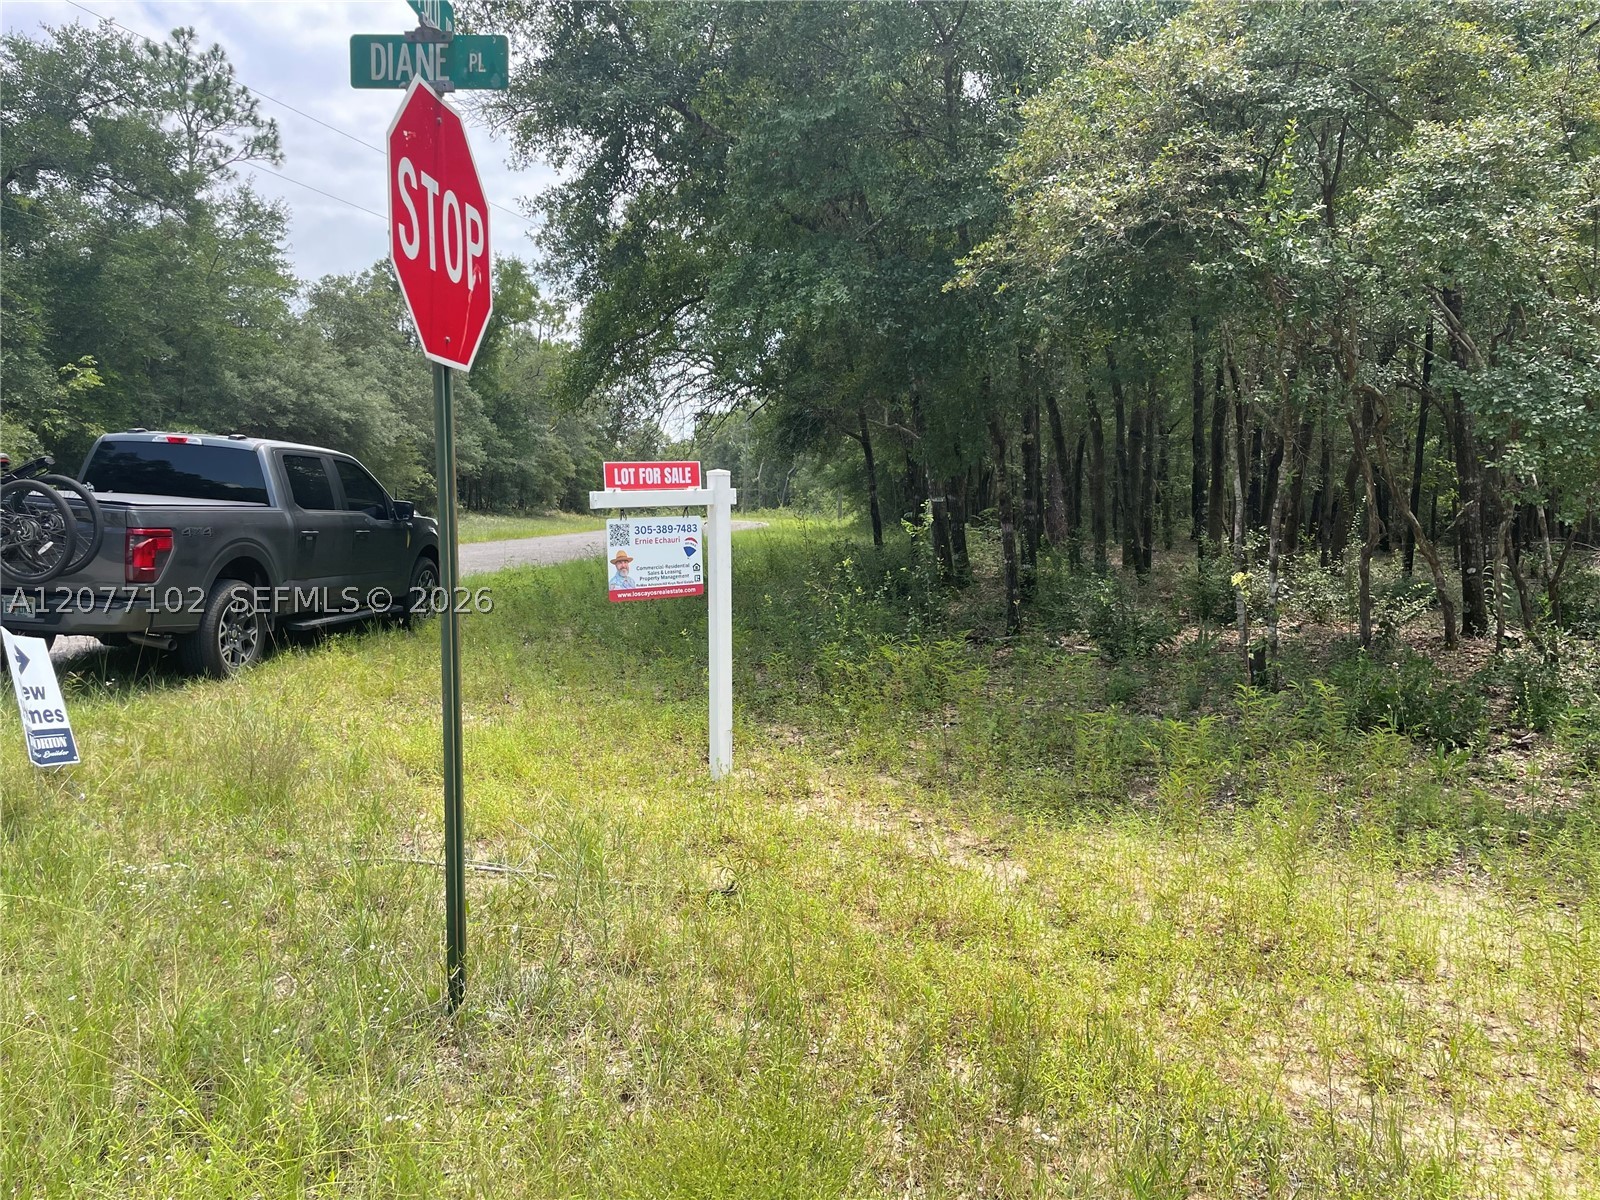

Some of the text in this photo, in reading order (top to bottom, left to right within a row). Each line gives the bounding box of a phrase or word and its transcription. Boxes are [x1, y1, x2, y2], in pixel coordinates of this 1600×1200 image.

[370, 43, 487, 81] DIANE PL
[398, 156, 484, 291] STOP
[614, 467, 692, 485] LOT FOR SALE
[634, 524, 698, 535] 305-389-7483
[654, 536, 681, 544] Echauri
[22, 686, 46, 701] ew
